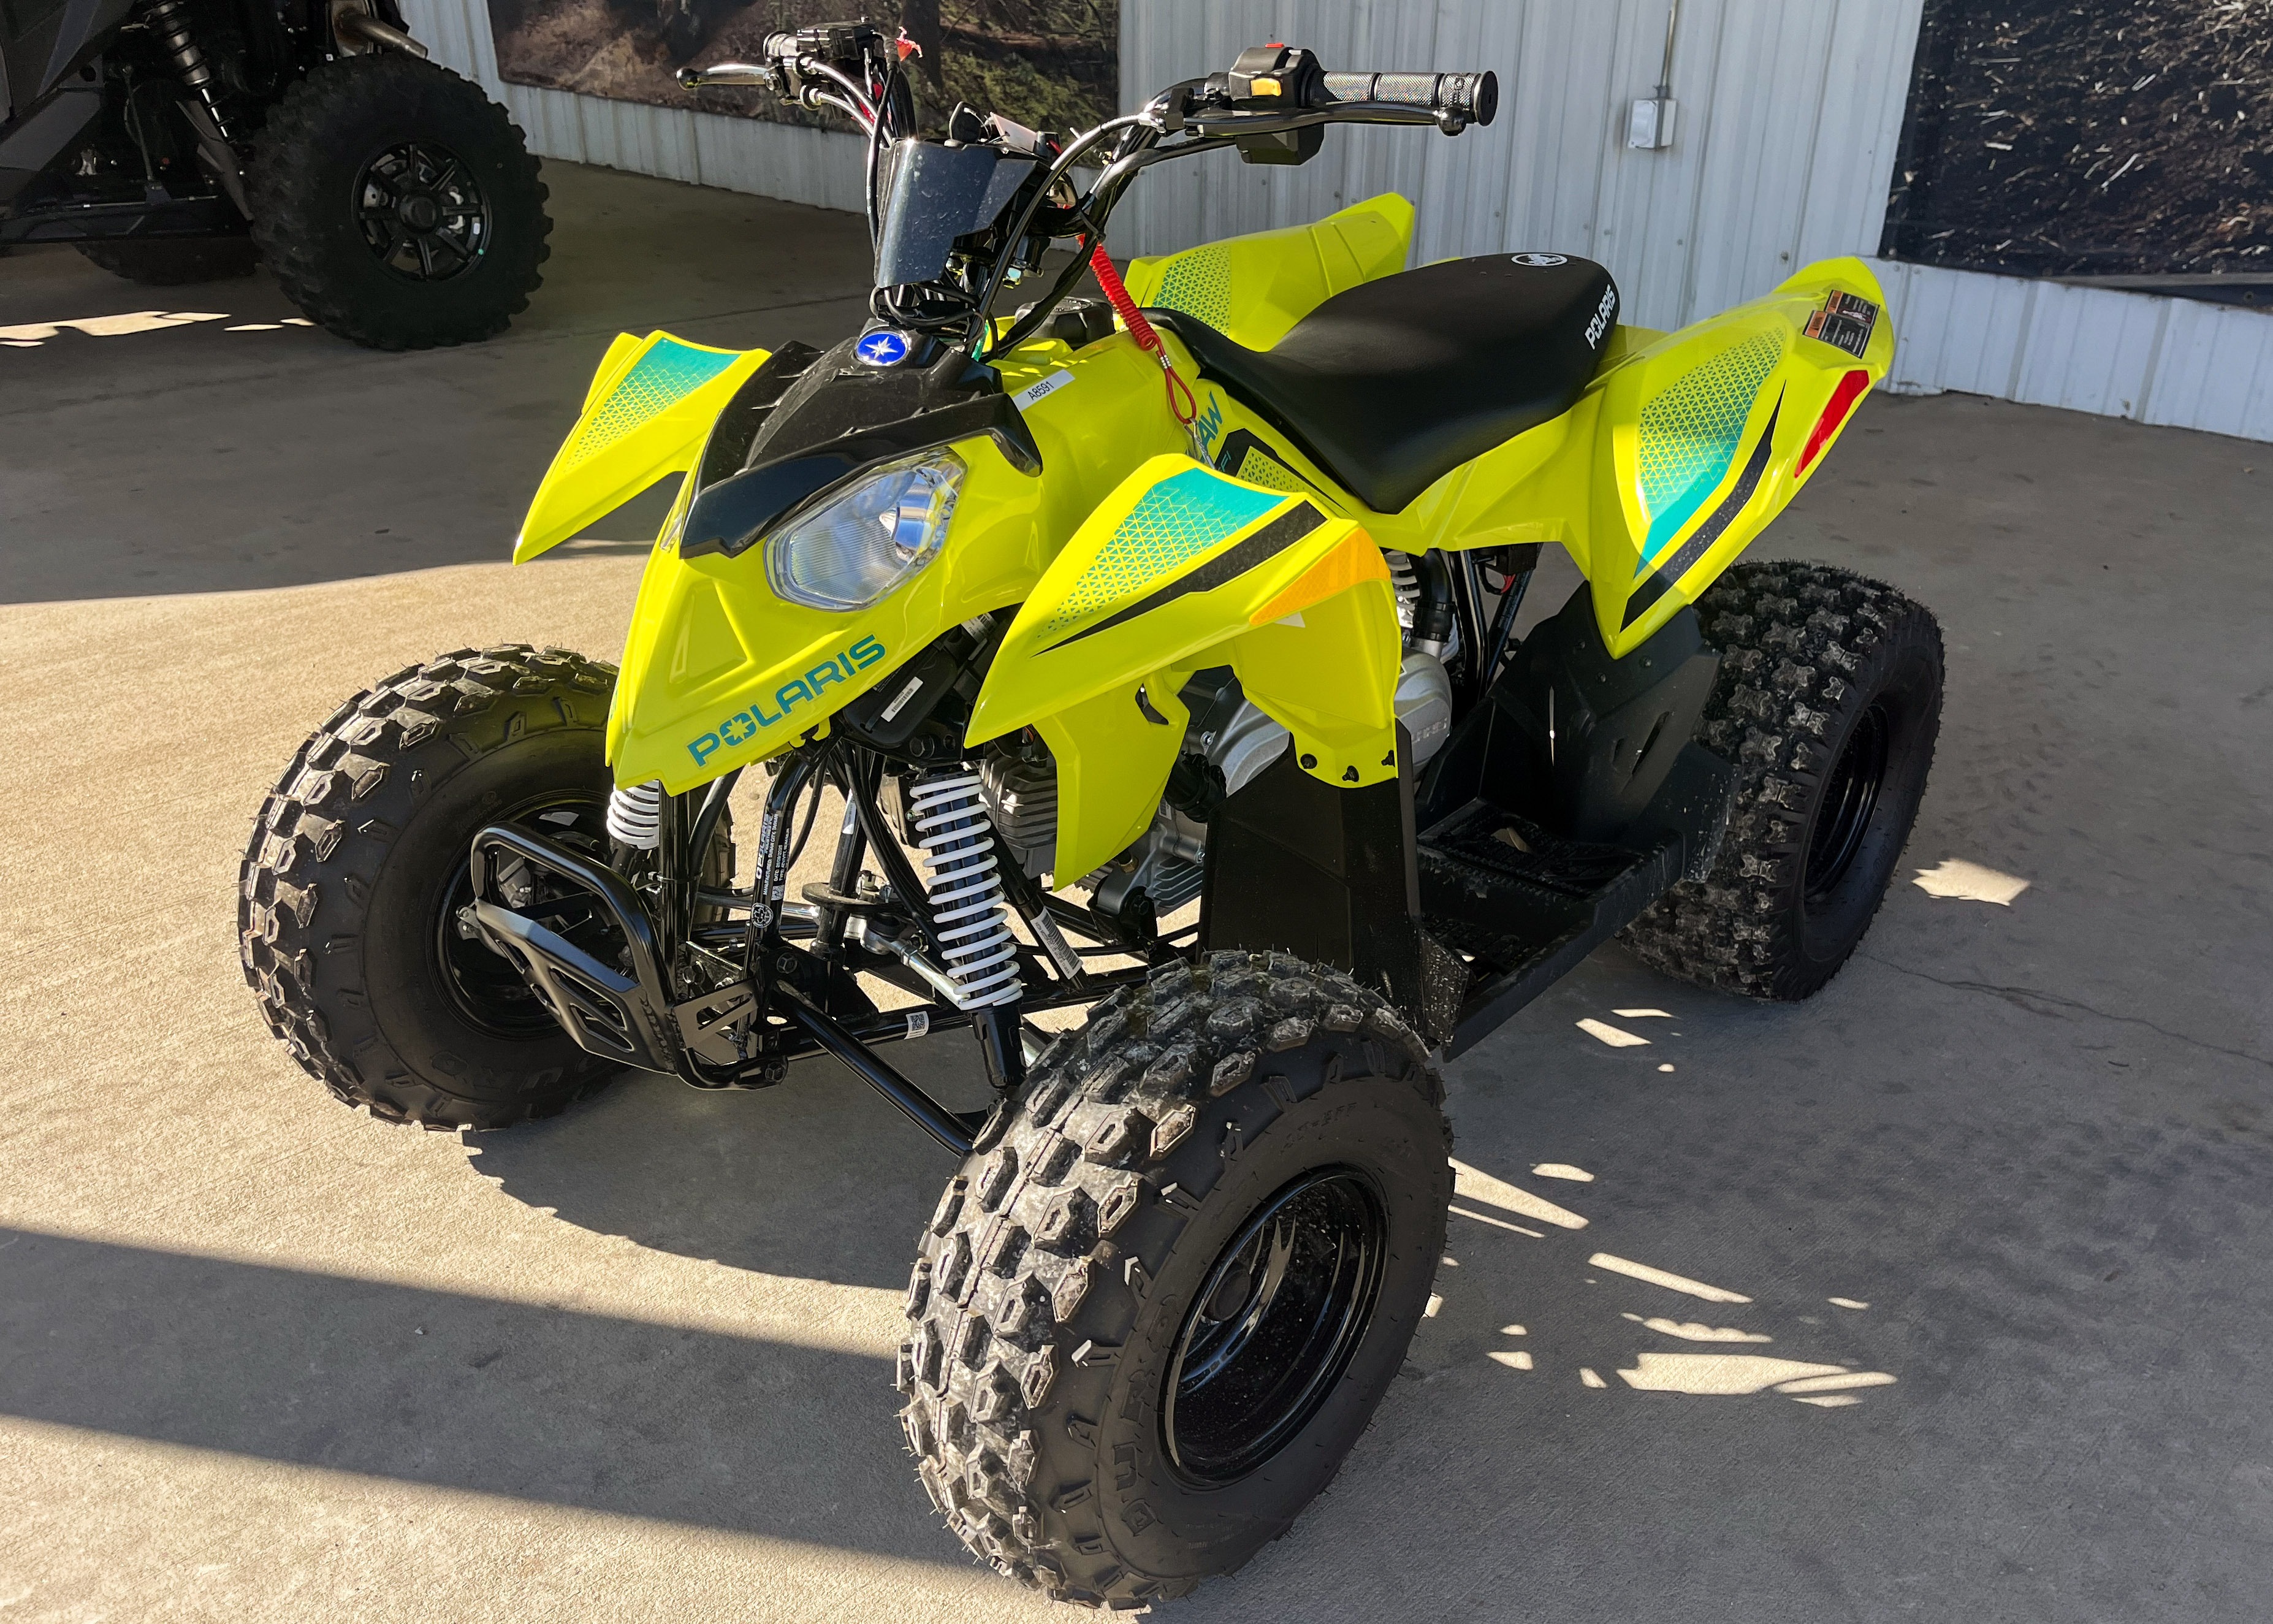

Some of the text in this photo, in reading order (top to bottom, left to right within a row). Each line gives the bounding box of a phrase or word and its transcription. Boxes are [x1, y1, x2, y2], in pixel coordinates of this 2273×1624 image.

[1585, 284, 1616, 350] POLARIS
[1027, 381, 1054, 400] A8591
[687, 634, 886, 767] POLARIS
[758, 814, 769, 867] POLARIS
